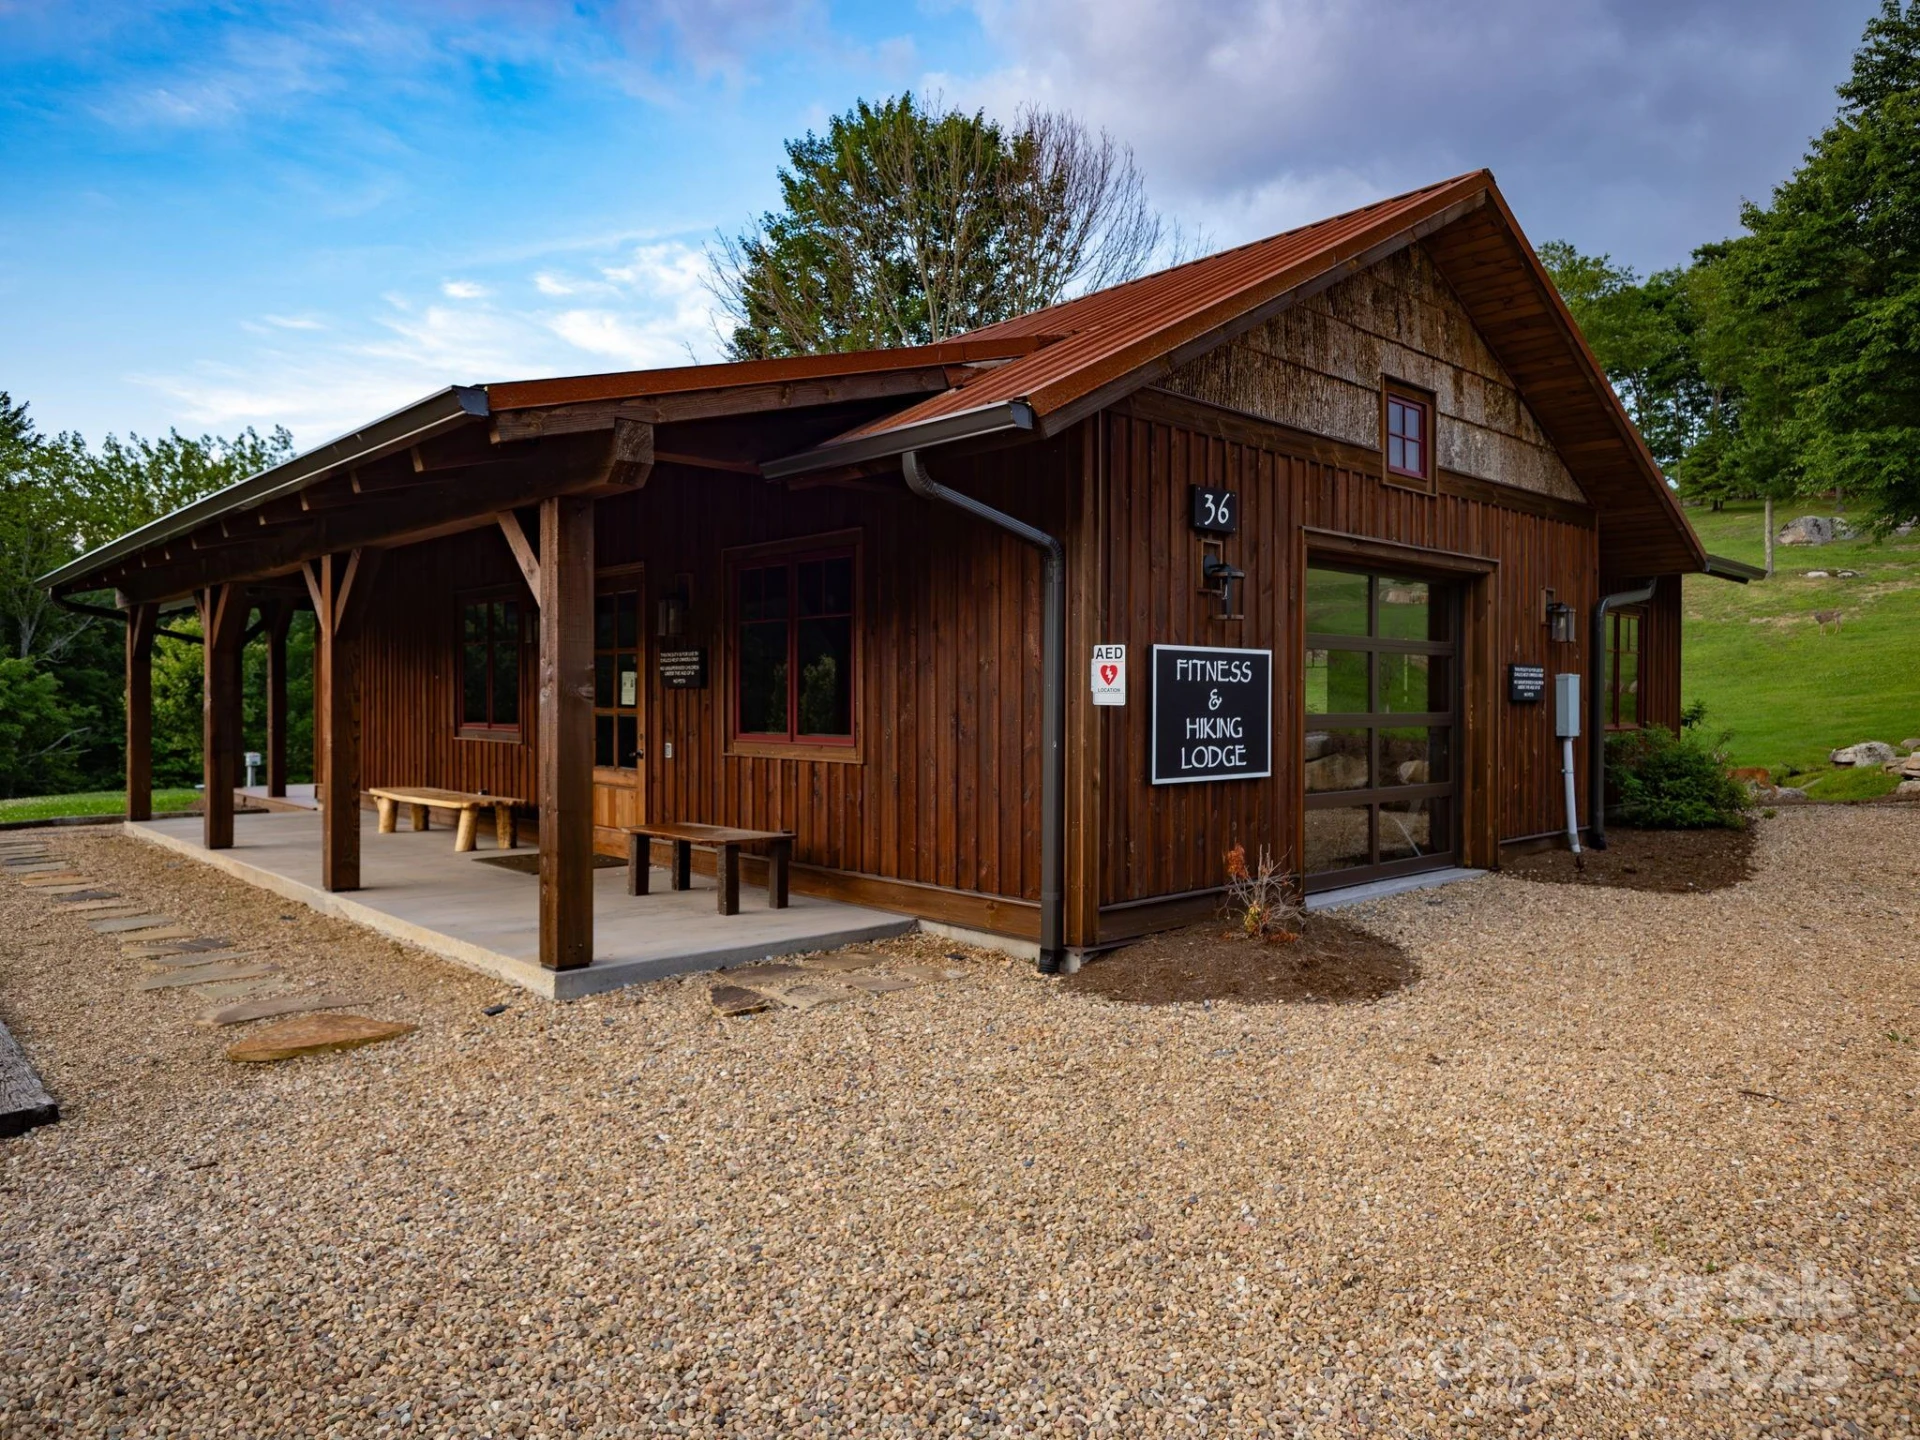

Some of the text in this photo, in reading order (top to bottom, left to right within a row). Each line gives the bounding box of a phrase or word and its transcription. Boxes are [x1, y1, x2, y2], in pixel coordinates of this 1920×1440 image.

[1204, 493, 1230, 525] 36
[1095, 647, 1123, 660] AED
[1176, 659, 1252, 683] FITNESS
[1208, 688, 1223, 711] &
[1186, 717, 1243, 740] HIKING
[1181, 745, 1247, 769] LODGE
